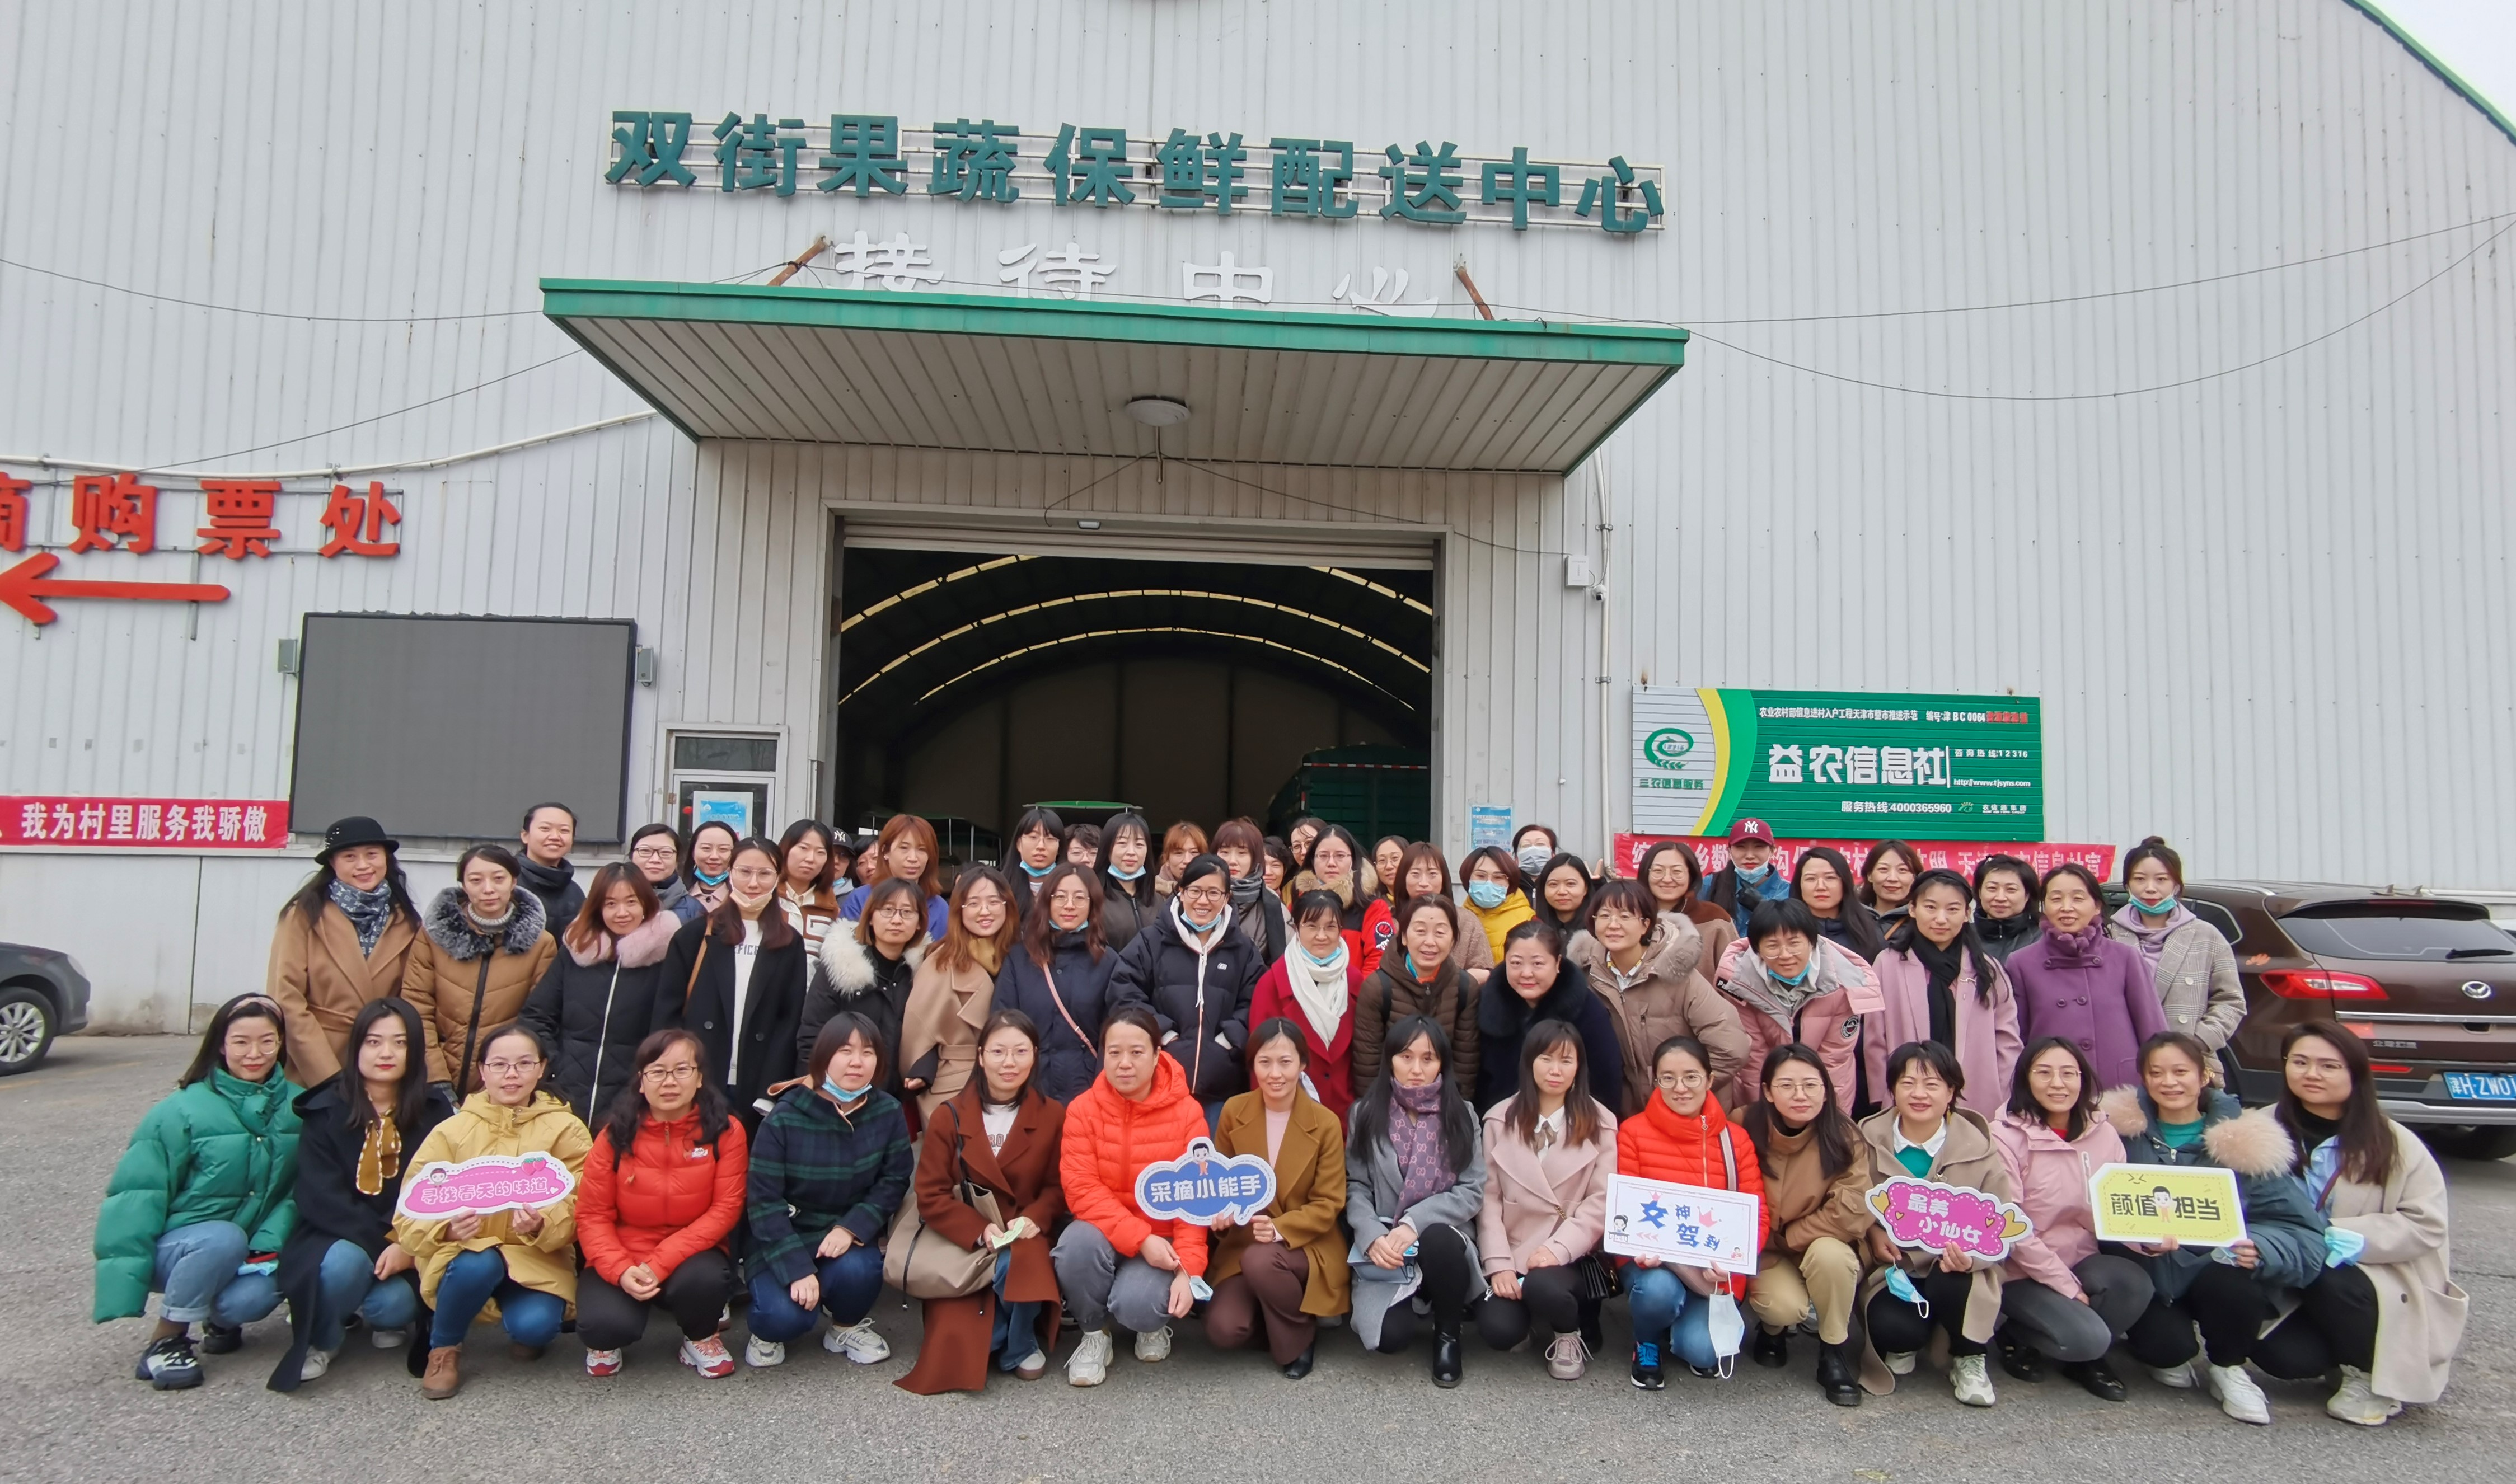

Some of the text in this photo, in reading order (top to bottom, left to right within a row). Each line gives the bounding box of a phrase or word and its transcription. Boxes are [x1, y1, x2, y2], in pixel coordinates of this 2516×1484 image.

[606, 110, 1663, 234] 双街果蔬保鲜配送中心
[828, 231, 1438, 317] 接待中心
[1769, 744, 1946, 785] 益农信息社
[21, 801, 268, 842] 我为村里服务我骄傲
[1744, 820, 1758, 833] NY
[421, 1177, 548, 1205] 寻找春天的味道
[1150, 1174, 1261, 1203] 采摘小能手
[1907, 1193, 1950, 1218] 最美
[2110, 1193, 2221, 1220] 颜值 担当
[1918, 1216, 1983, 1244] 小仙女
